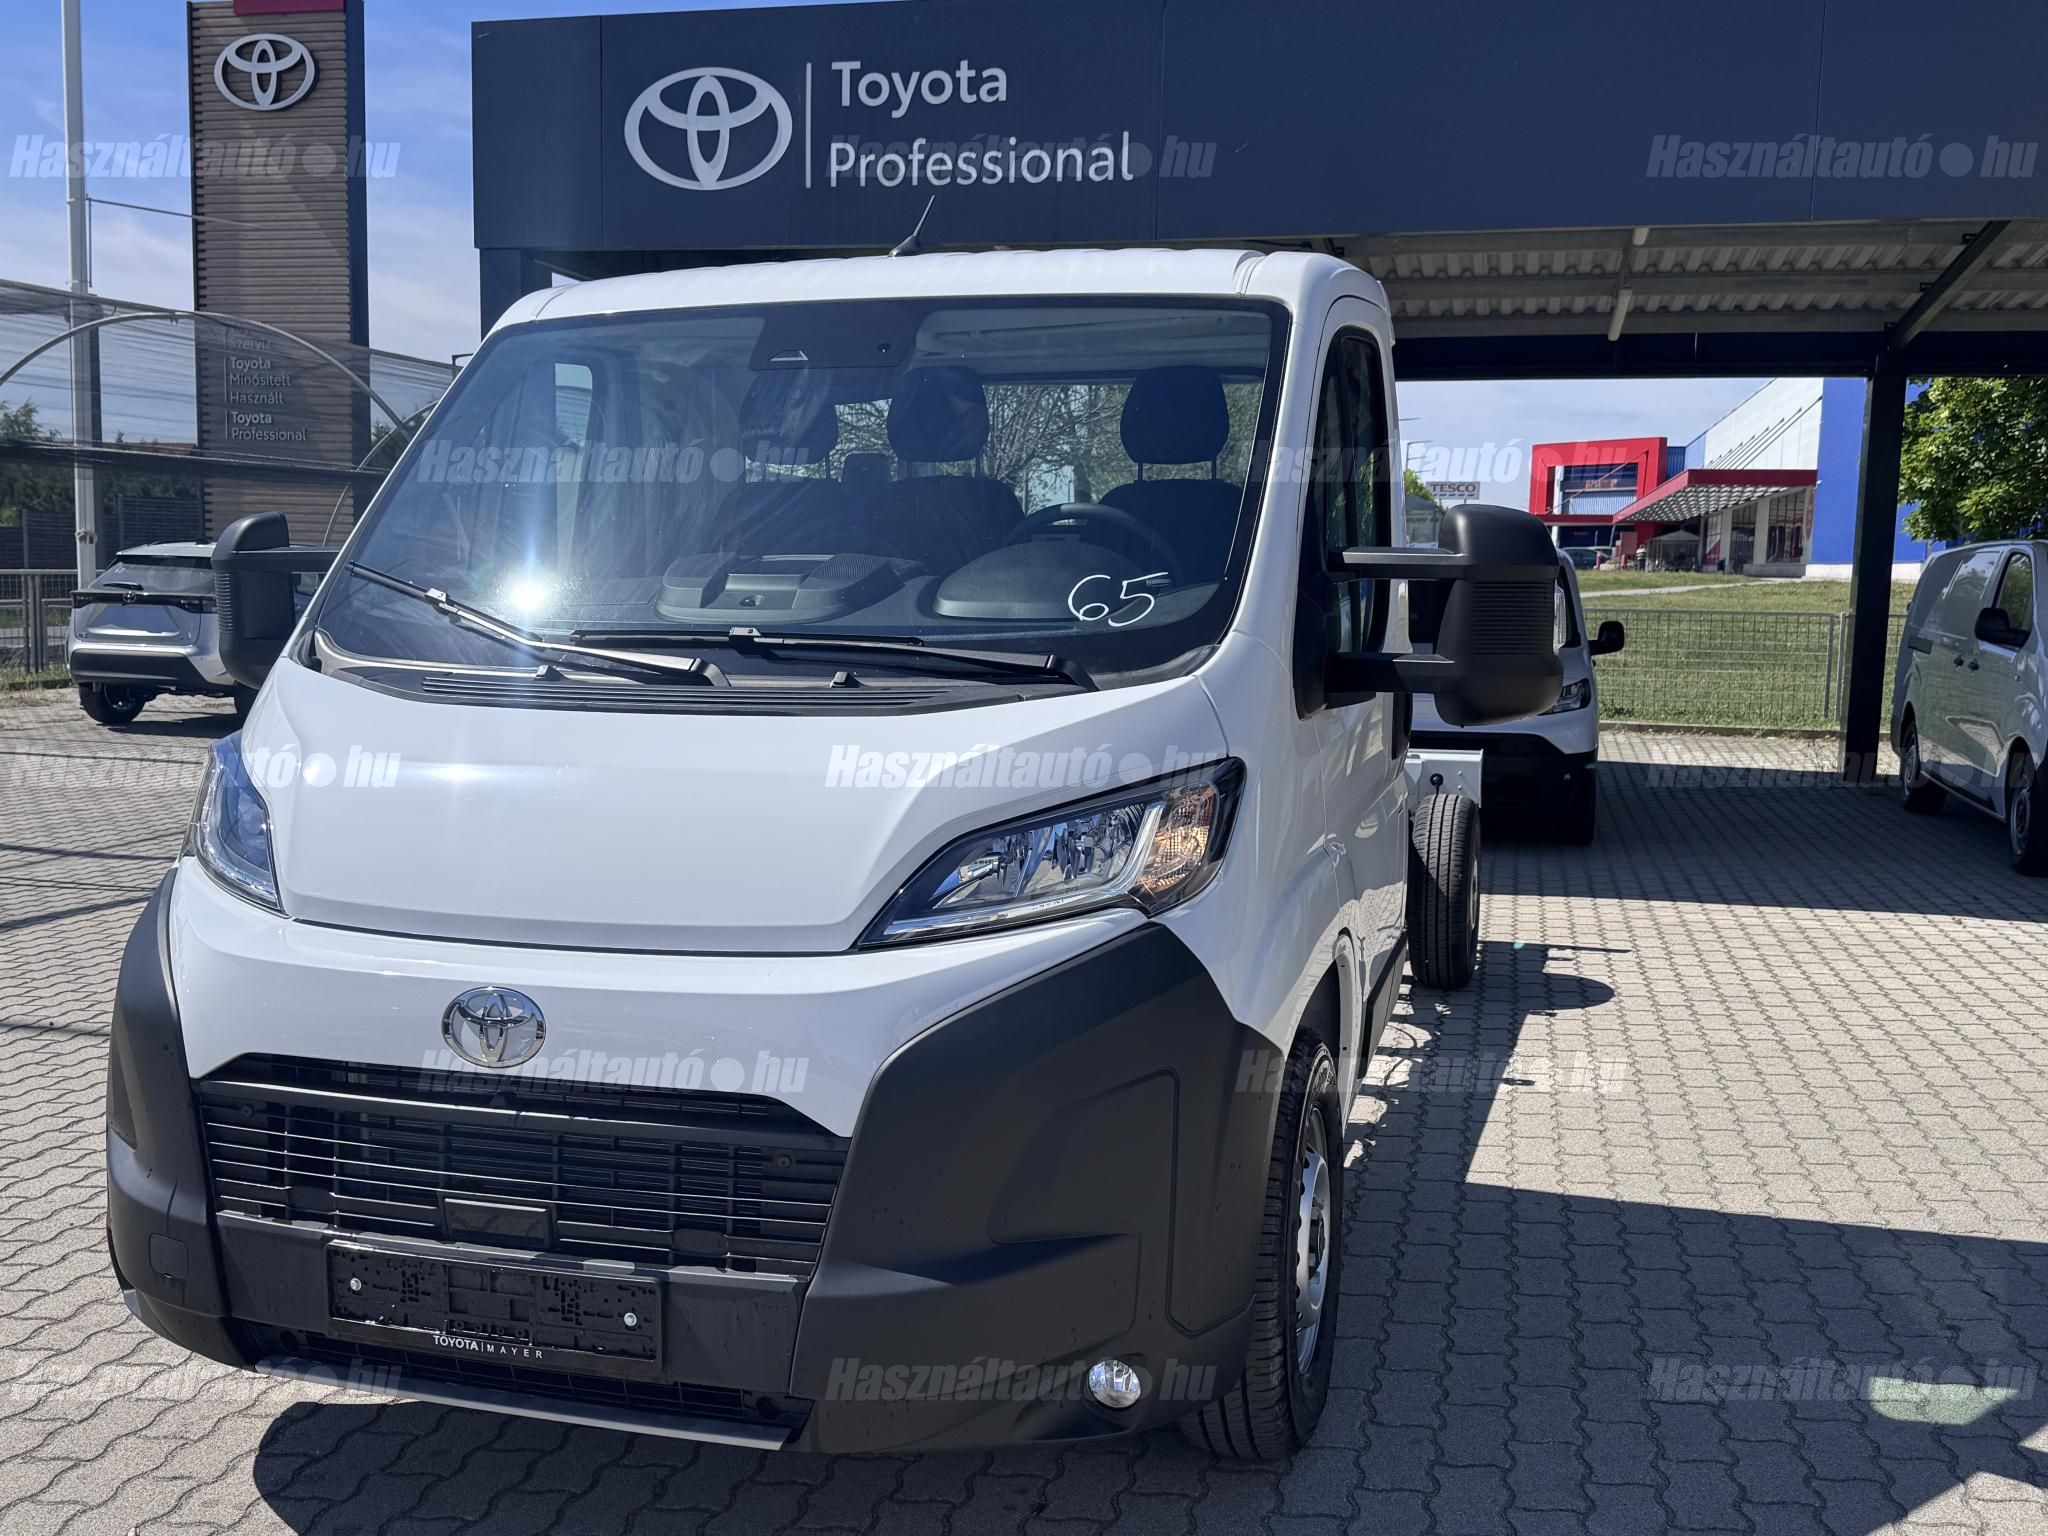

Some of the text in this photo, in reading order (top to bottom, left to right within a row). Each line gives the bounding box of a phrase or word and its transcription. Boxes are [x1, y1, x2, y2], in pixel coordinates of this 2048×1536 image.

[831, 59, 1008, 119] Toyota
[830, 131, 1134, 188] Professional
[229, 356, 272, 373] Toyota
[230, 391, 285, 405] Használt
[231, 411, 273, 426] Toyota
[231, 426, 307, 441] Professional
[1430, 483, 1476, 493] TESCO
[1067, 572, 1169, 628] 65
[432, 1334, 543, 1359] TOYOTA MAYER
